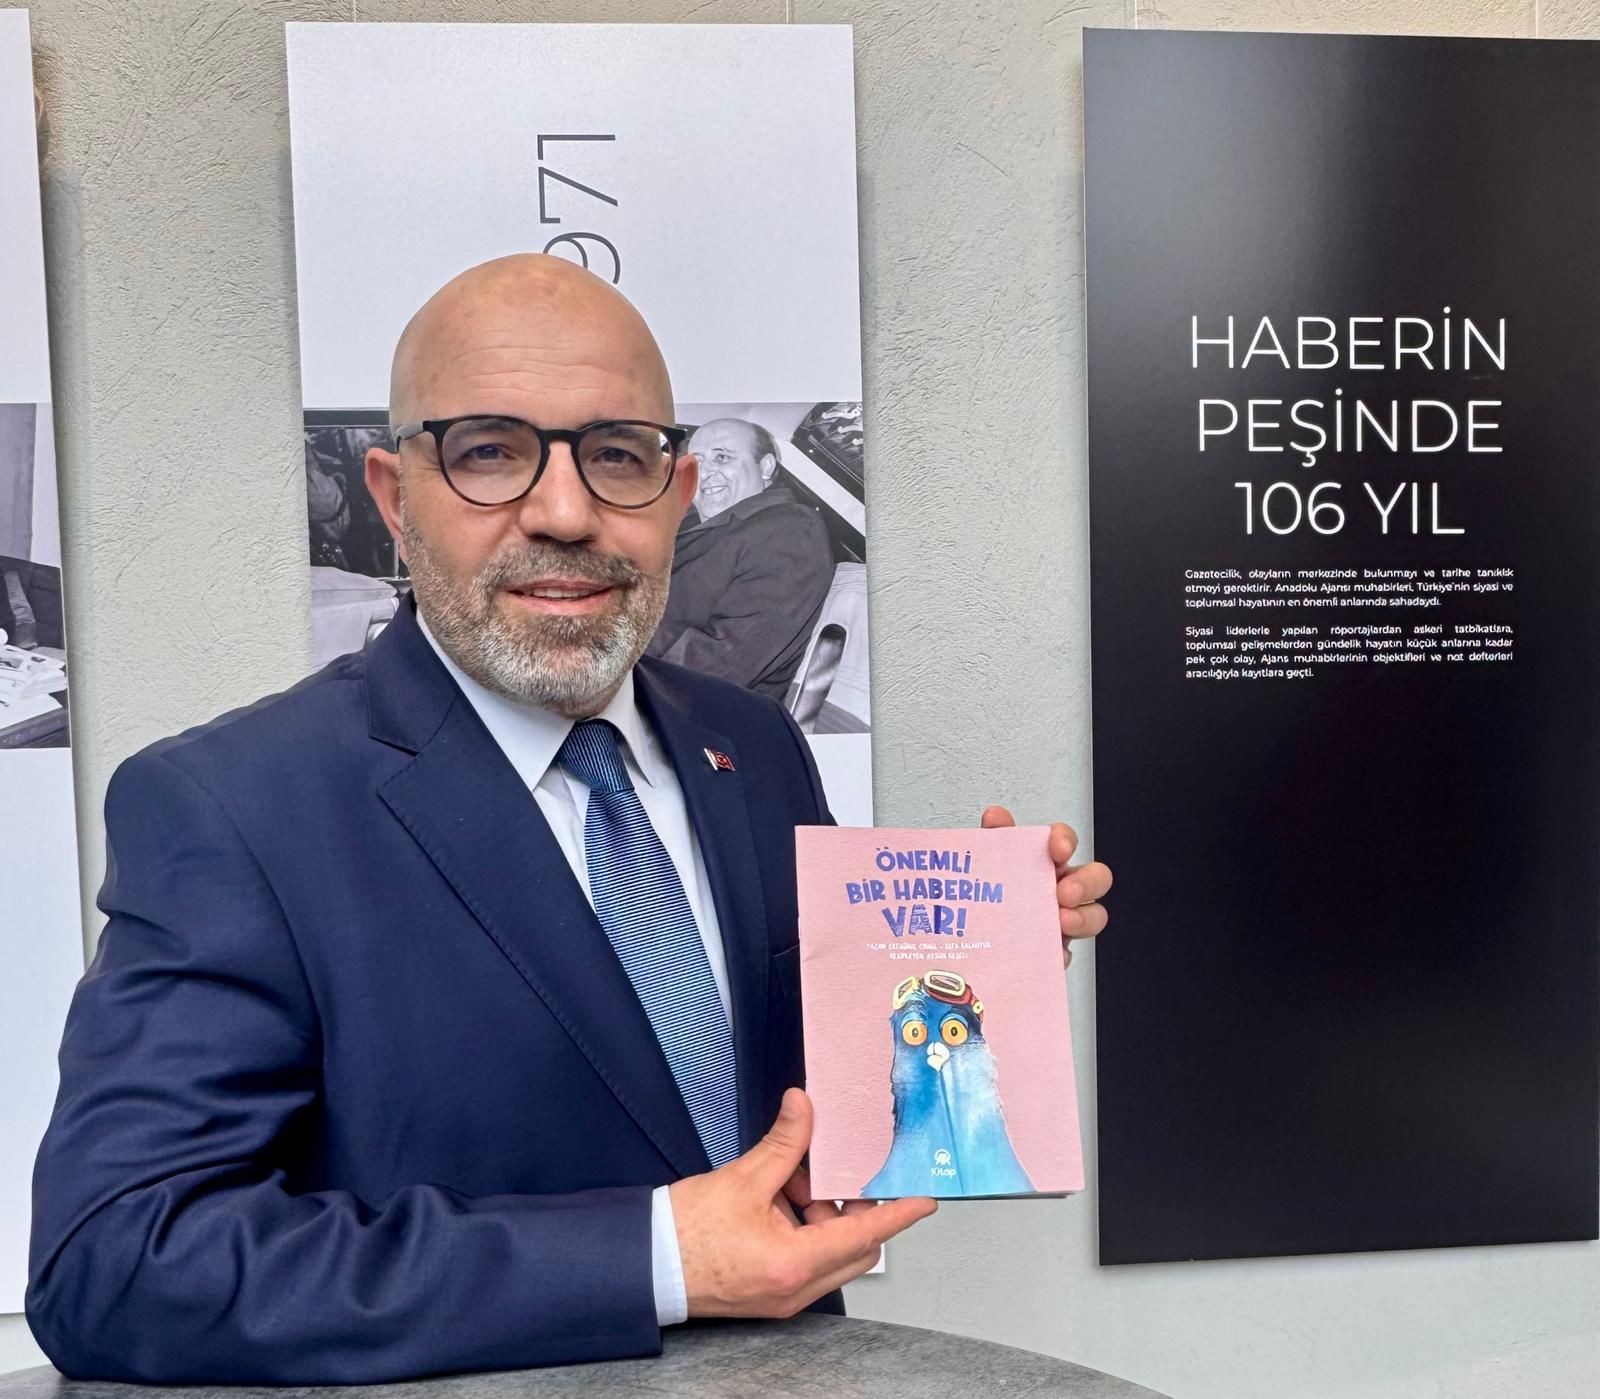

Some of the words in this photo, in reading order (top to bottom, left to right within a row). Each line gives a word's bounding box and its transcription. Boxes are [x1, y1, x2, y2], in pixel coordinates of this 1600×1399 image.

[1192, 307, 1505, 370] HABERİN
[1199, 389, 1502, 467] PEŞİNDE
[1235, 482, 1344, 534] 106
[1364, 483, 1464, 534] YIL
[1184, 569, 1242, 579] Gazetecilik,
[1248, 569, 1291, 580] olayların
[1297, 569, 1357, 578] merkezinde
[1363, 569, 1417, 579] bulunmayı
[1441, 568, 1470, 577] tarihe
[1274, 583, 1317, 592] Anadolu
[1472, 582, 1498, 593] siyasi
[1184, 598, 1236, 608] toplumsal
[1238, 598, 1285, 609] hayatının
[1302, 597, 1338, 606] önemli
[1185, 627, 1213, 637] Siyasi
[1226, 626, 1270, 635] liderlerle
[1281, 626, 1318, 636] yapılan
[1330, 625, 1401, 636] röportajlardan
[1413, 625, 1442, 633] askeri
[1185, 641, 1236, 651] toplumsal
[1240, 640, 1312, 651] gelişmelerden
[1316, 639, 1361, 650] gündelik
[1365, 639, 1402, 650] hayatın
[1406, 639, 1437, 649] küçük
[1485, 638, 1513, 647] kadar
[1185, 655, 1205, 665] pek
[1209, 655, 1228, 665] çok
[1260, 654, 1289, 665] Ajans
[1293, 653, 1367, 662] muhabirlerinin
[1468, 652, 1512, 661] defterleri
[1241, 668, 1284, 679] kayıtlara
[1285, 668, 1313, 679] geçti.
[875, 846, 971, 874] ÖNEMLİ
[846, 878, 886, 905] BİR
[893, 877, 1004, 904] HABERİM
[881, 904, 967, 938] VAR!
